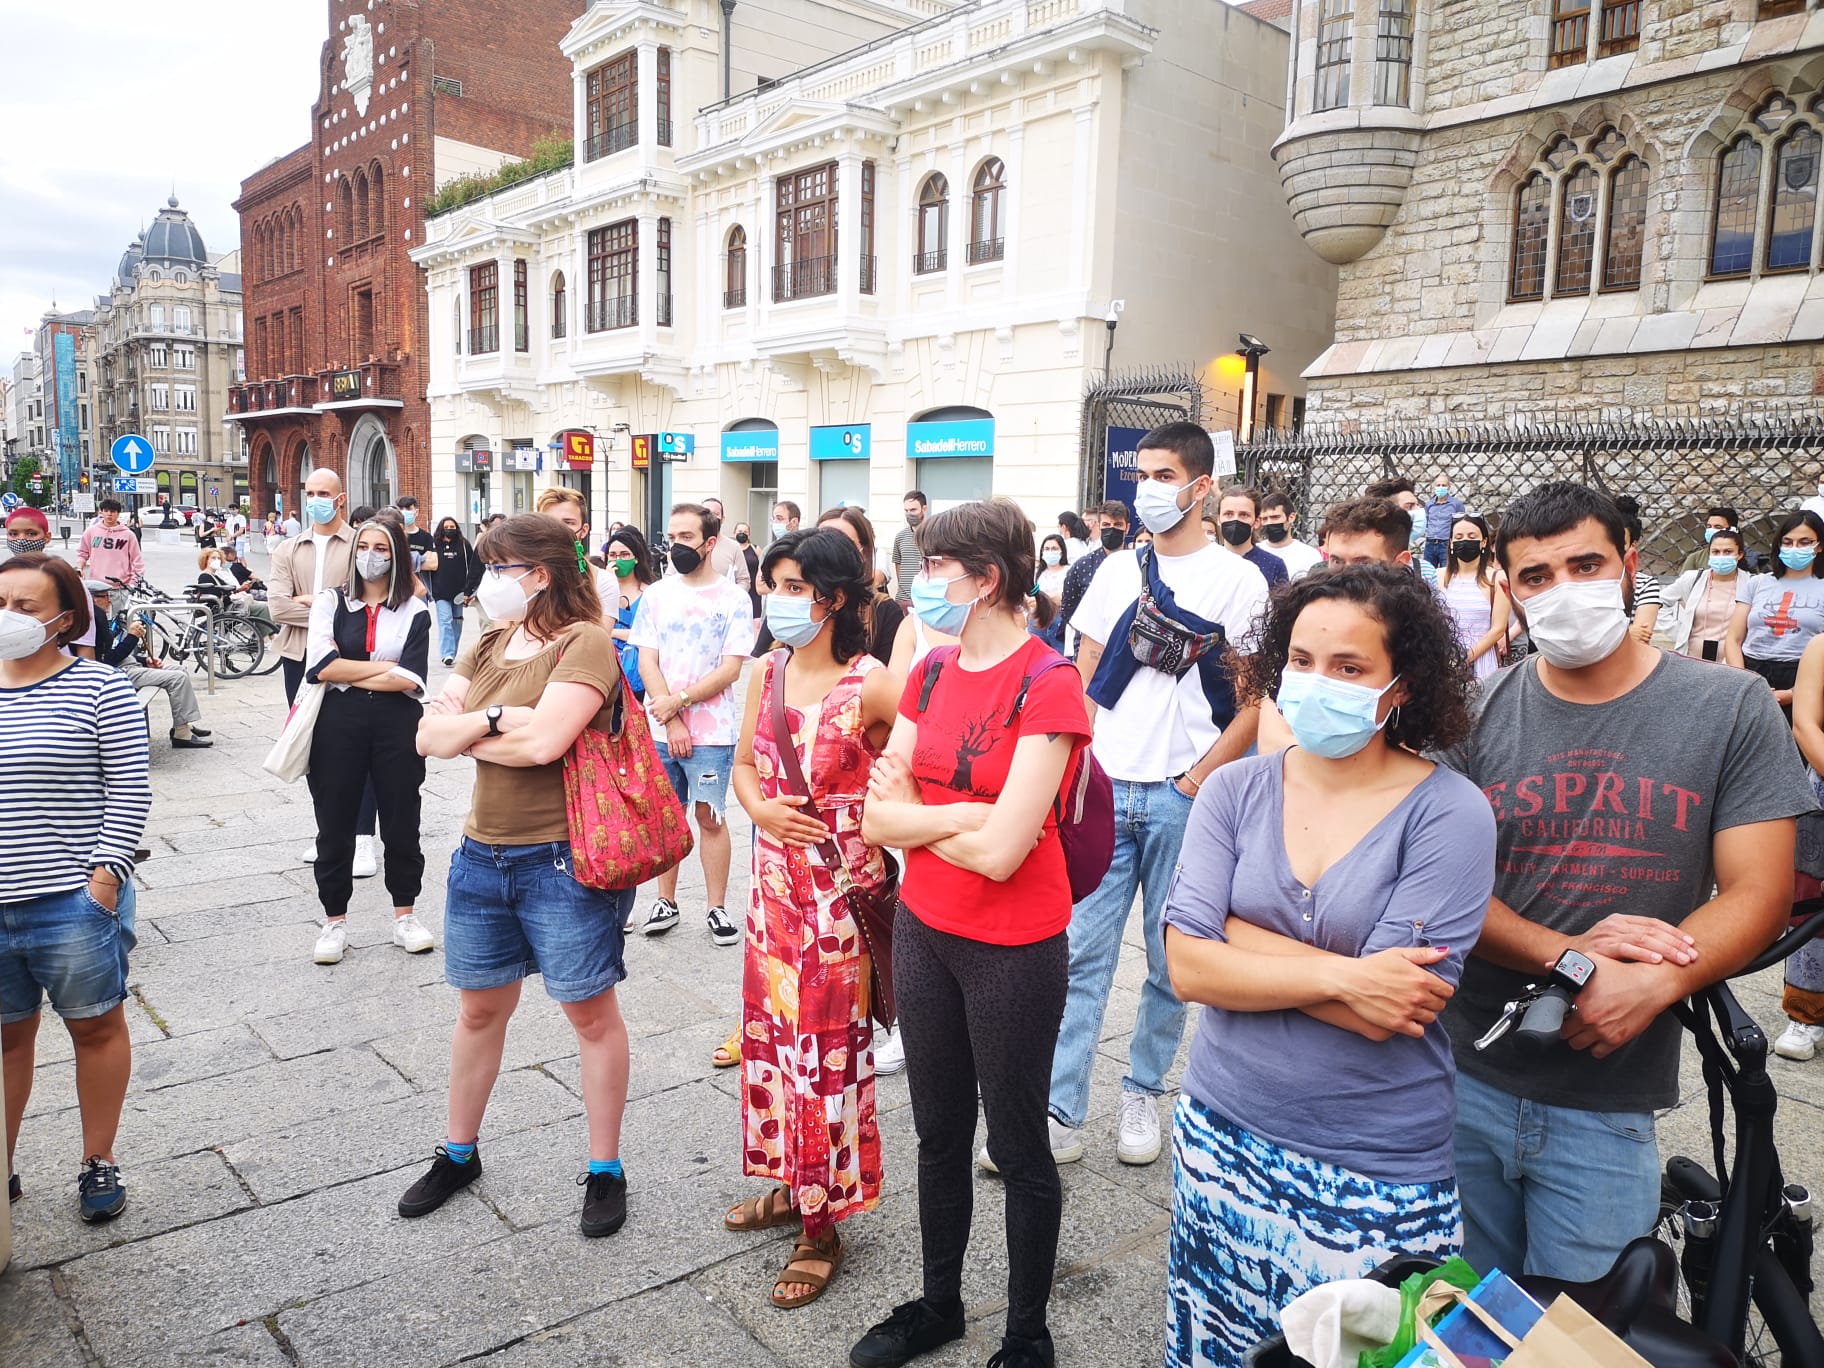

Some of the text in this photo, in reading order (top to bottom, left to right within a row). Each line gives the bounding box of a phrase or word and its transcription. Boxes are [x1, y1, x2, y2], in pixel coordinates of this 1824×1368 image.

[914, 438, 987, 453] SabadellHerrero
[1484, 772, 1702, 832] ESPRIT
[1521, 817, 1648, 841] CALIFORNIA
[1620, 867, 1680, 883] SUPPLIES
